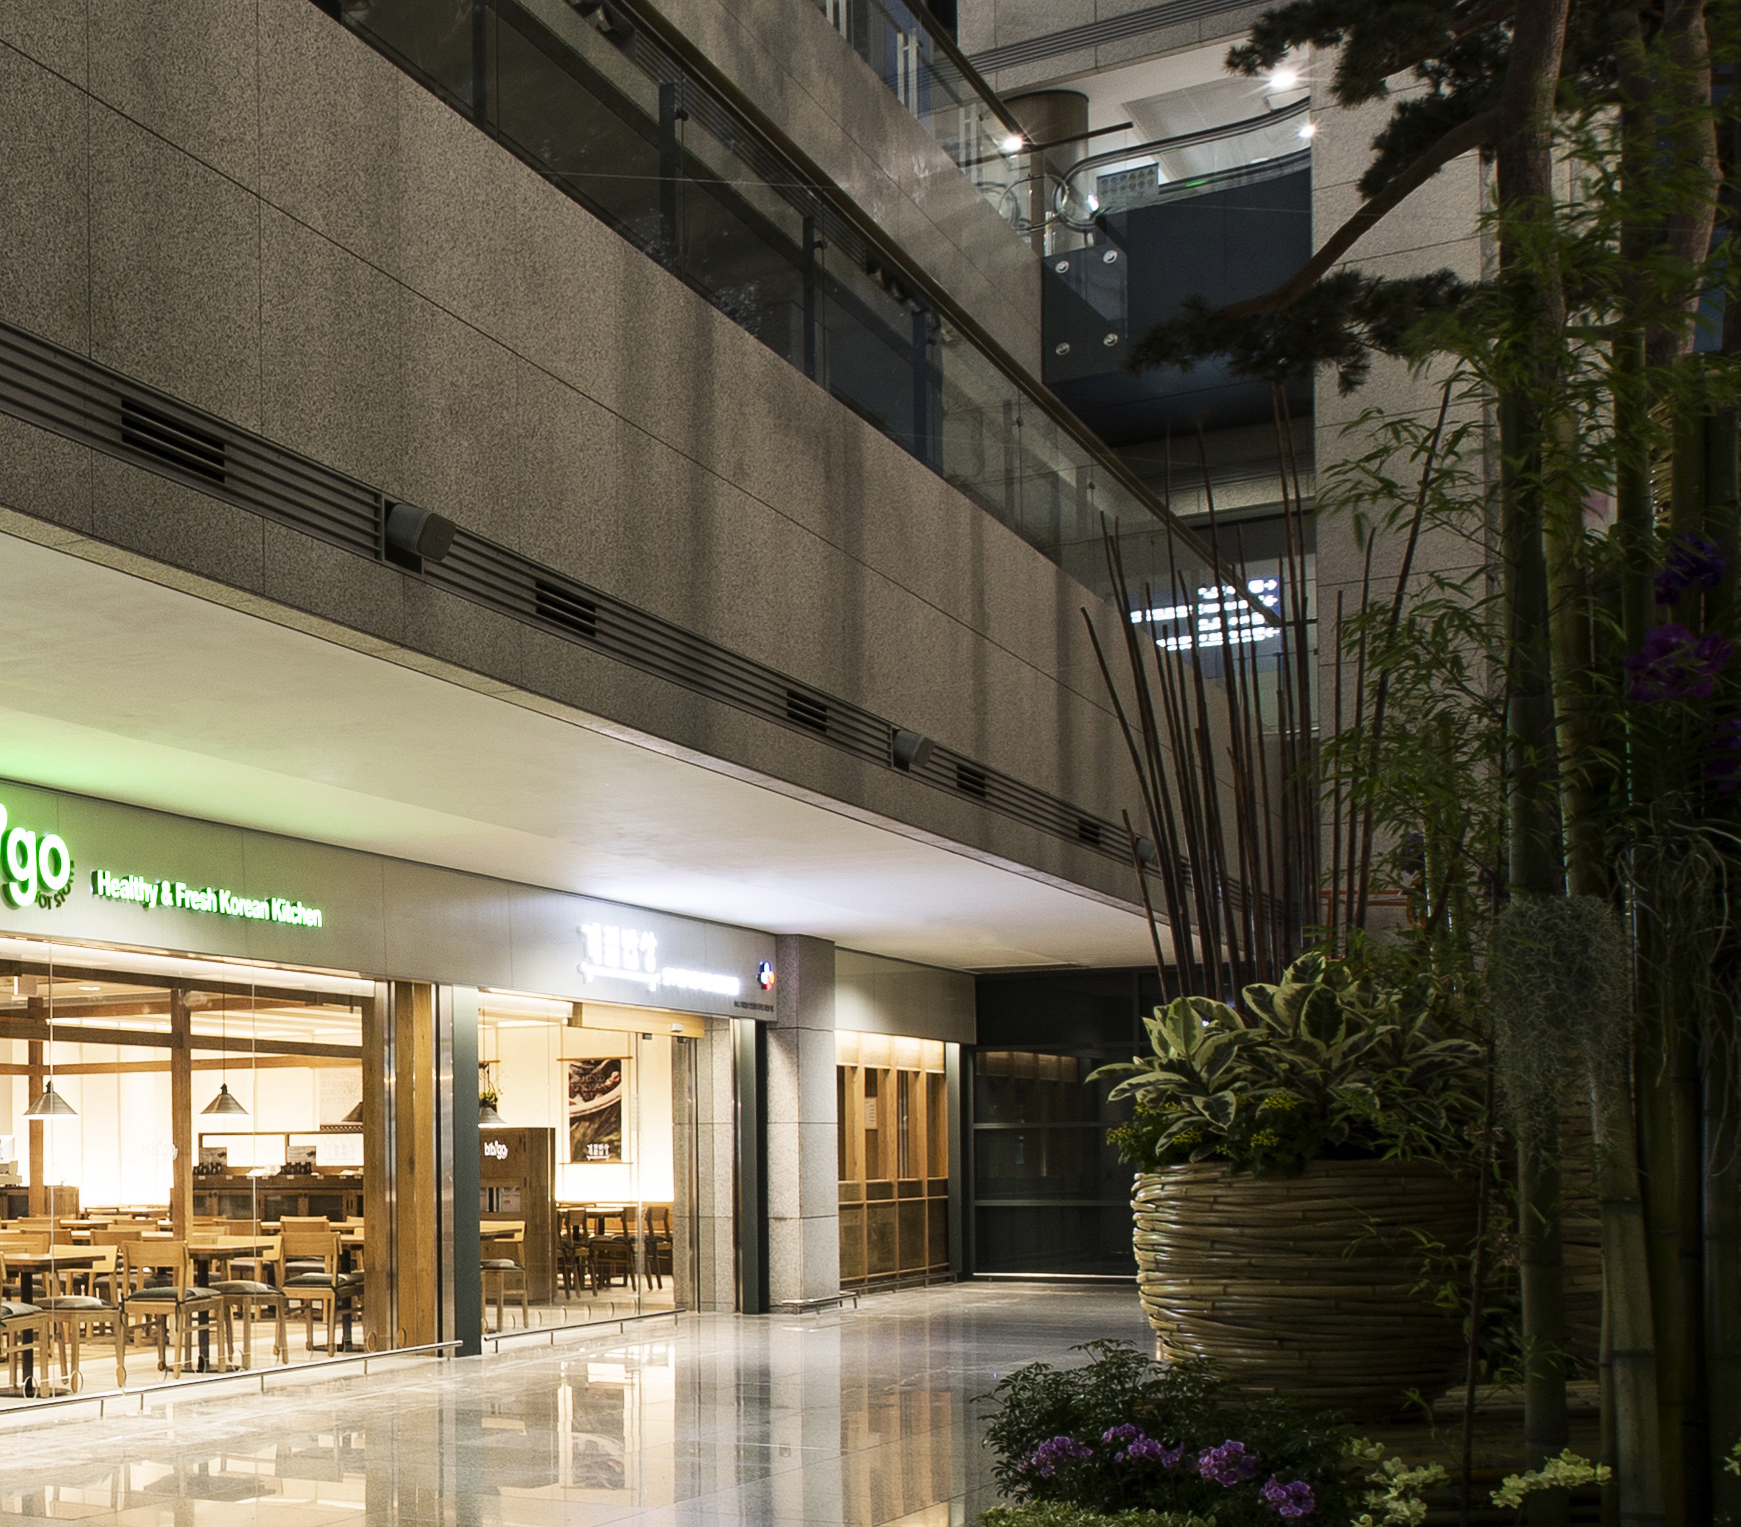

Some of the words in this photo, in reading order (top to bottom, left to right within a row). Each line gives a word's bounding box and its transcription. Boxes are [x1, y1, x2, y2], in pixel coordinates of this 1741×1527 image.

[96, 869, 159, 909] Healthy
[160, 879, 175, 907] &
[175, 881, 218, 914] Fresh
[218, 888, 271, 921] Korean
[271, 897, 323, 928] Kitchen
